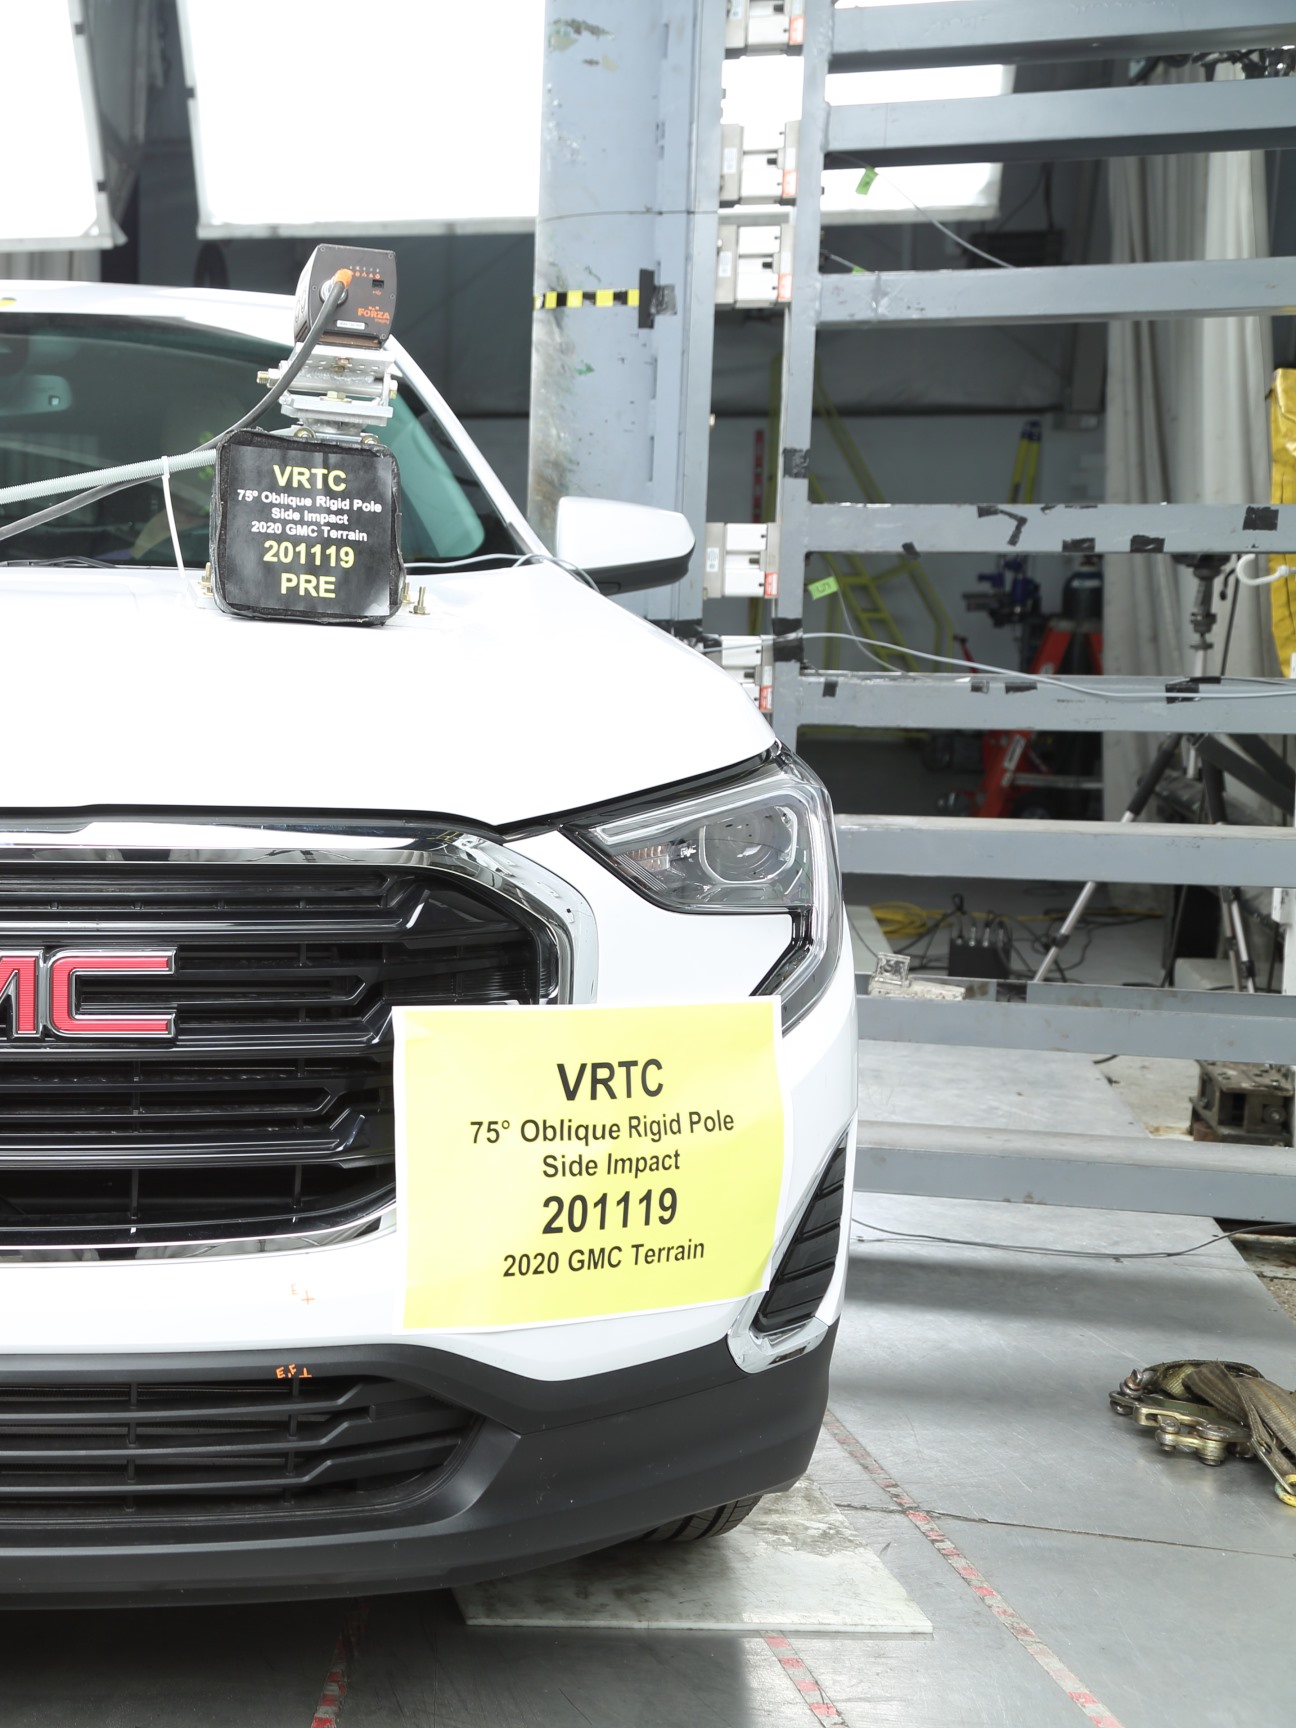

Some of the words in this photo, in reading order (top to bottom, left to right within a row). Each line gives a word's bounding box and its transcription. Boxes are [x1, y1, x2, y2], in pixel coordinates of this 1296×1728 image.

[272, 464, 347, 492] VRTC
[260, 490, 313, 509] Oblique
[315, 495, 350, 512] Rigid
[352, 498, 383, 513] Pole
[270, 507, 301, 521] Side
[303, 509, 349, 525] Impact
[250, 520, 283, 534] 2020
[285, 524, 319, 537] GMC
[321, 526, 368, 542] Terrain
[262, 539, 355, 569] 201119
[280, 572, 337, 599] PRE
[556, 1058, 664, 1101] VRTC
[520, 1118, 621, 1147] Oblique
[628, 1112, 682, 1143] Rigid
[688, 1109, 734, 1134] Pole
[542, 1154, 598, 1178] Side
[607, 1149, 681, 1179] Impact
[542, 1187, 678, 1235] 201119
[503, 1251, 560, 1277] 2020
[568, 1245, 623, 1272] GMC
[631, 1239, 705, 1266] Terrain
